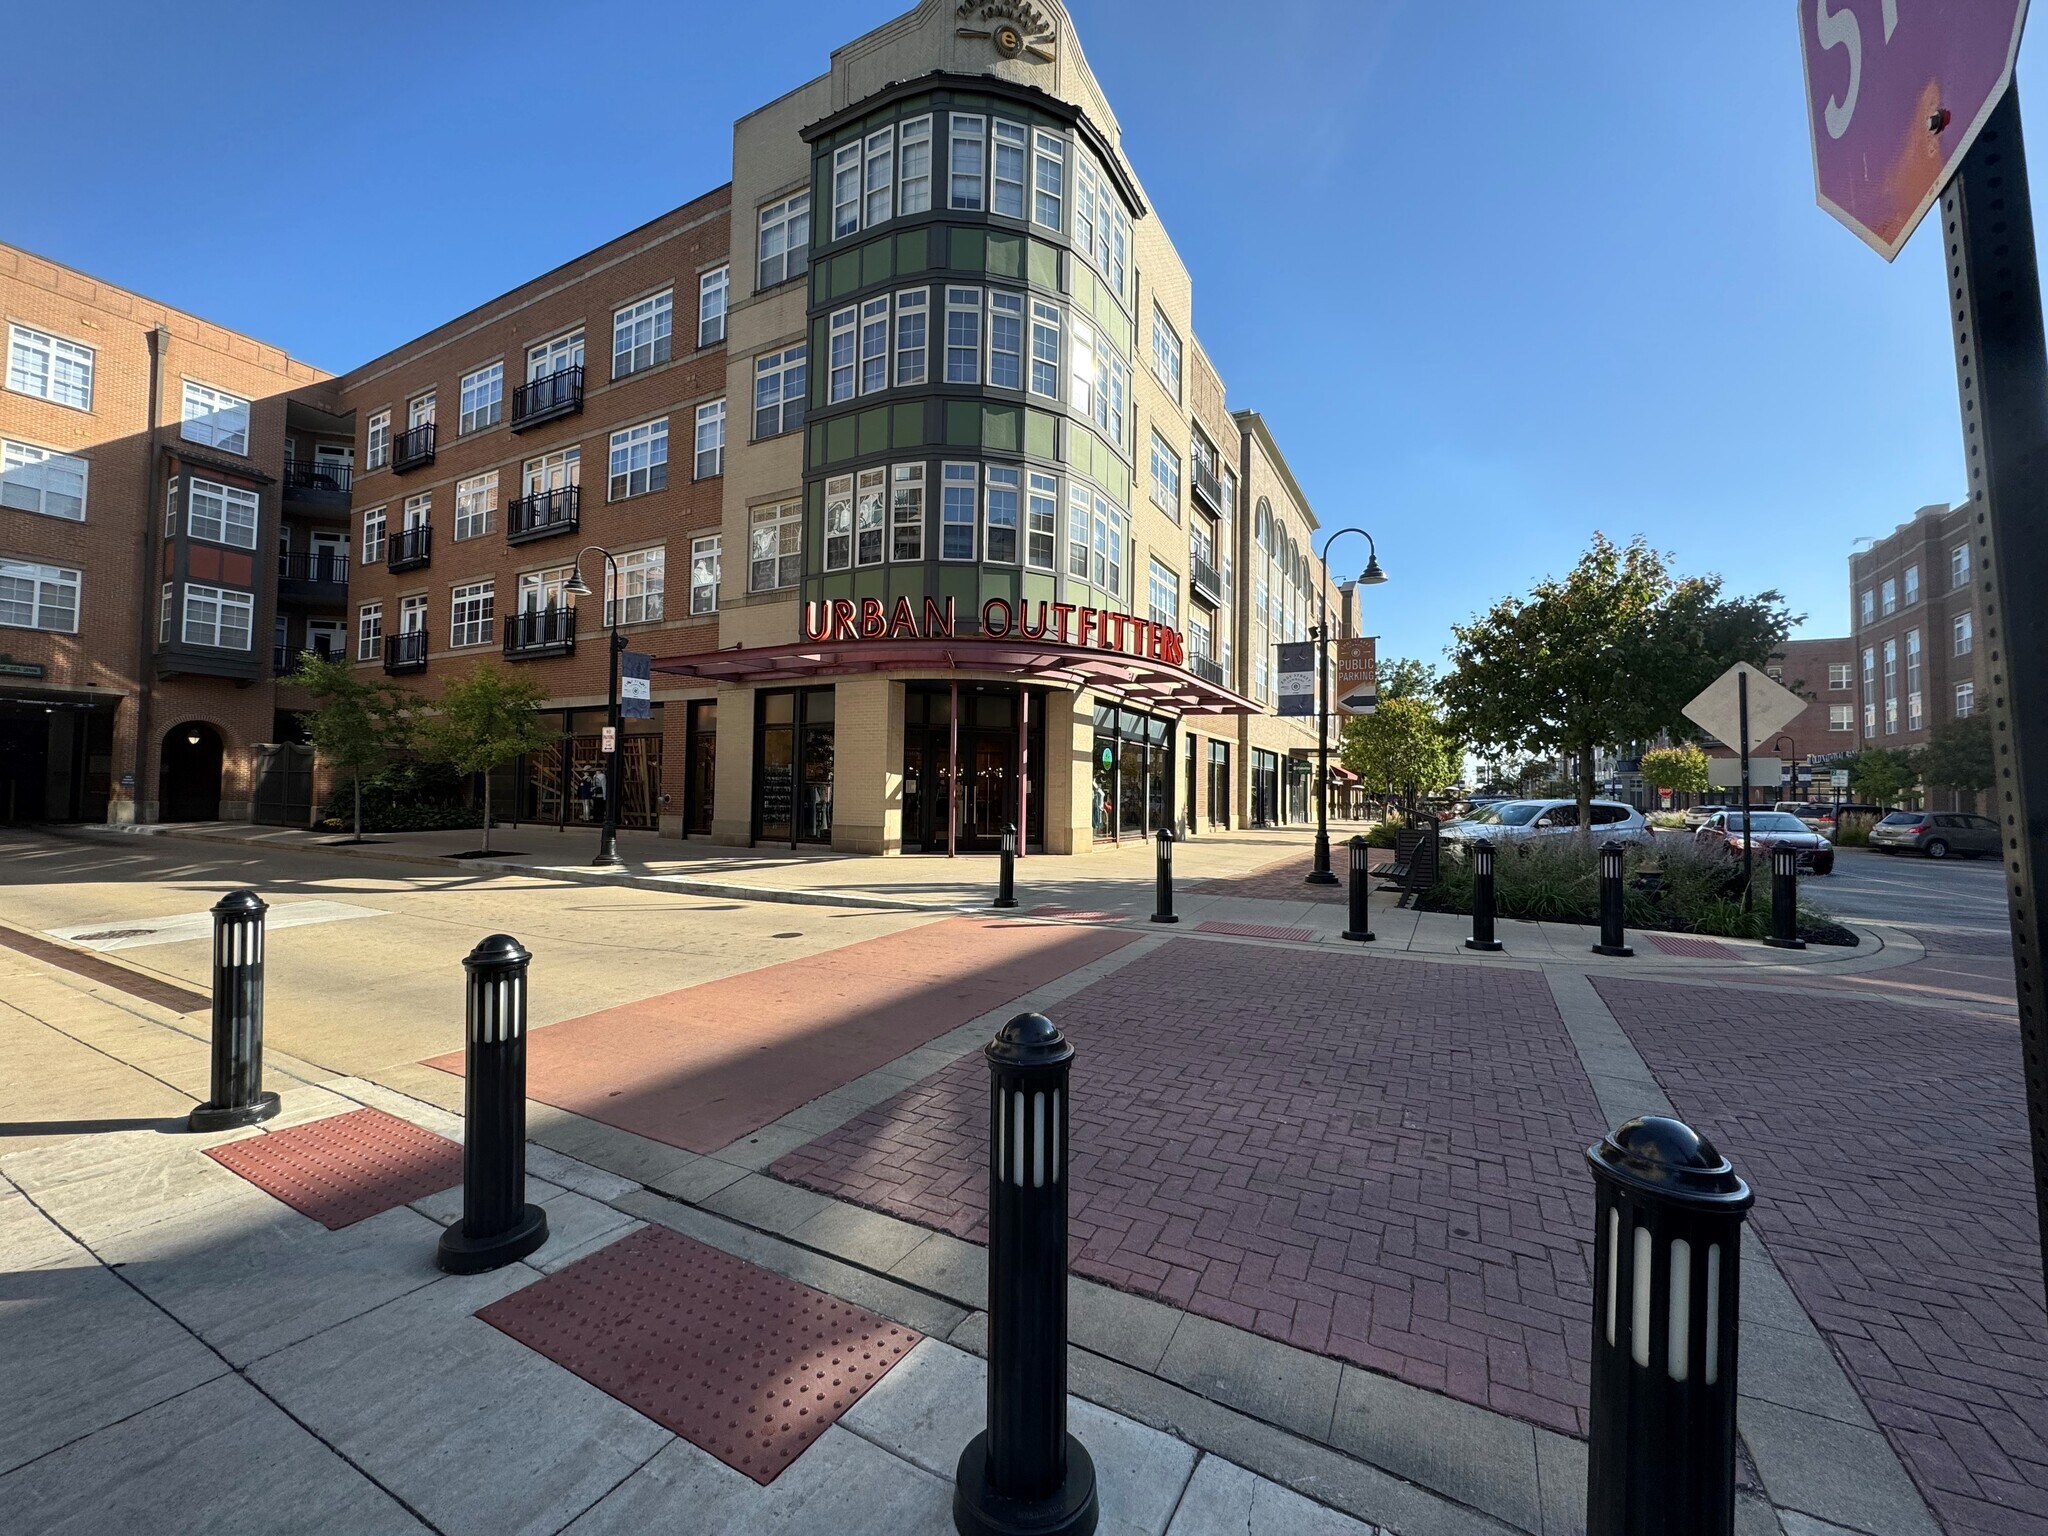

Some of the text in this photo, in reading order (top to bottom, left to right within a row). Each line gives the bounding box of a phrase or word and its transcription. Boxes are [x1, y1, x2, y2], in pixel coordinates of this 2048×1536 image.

[805, 595, 1184, 666] URBAN OUTFITTERS
[1338, 658, 1374, 671] PUBLIC
[1338, 671, 1374, 682] PARKING
